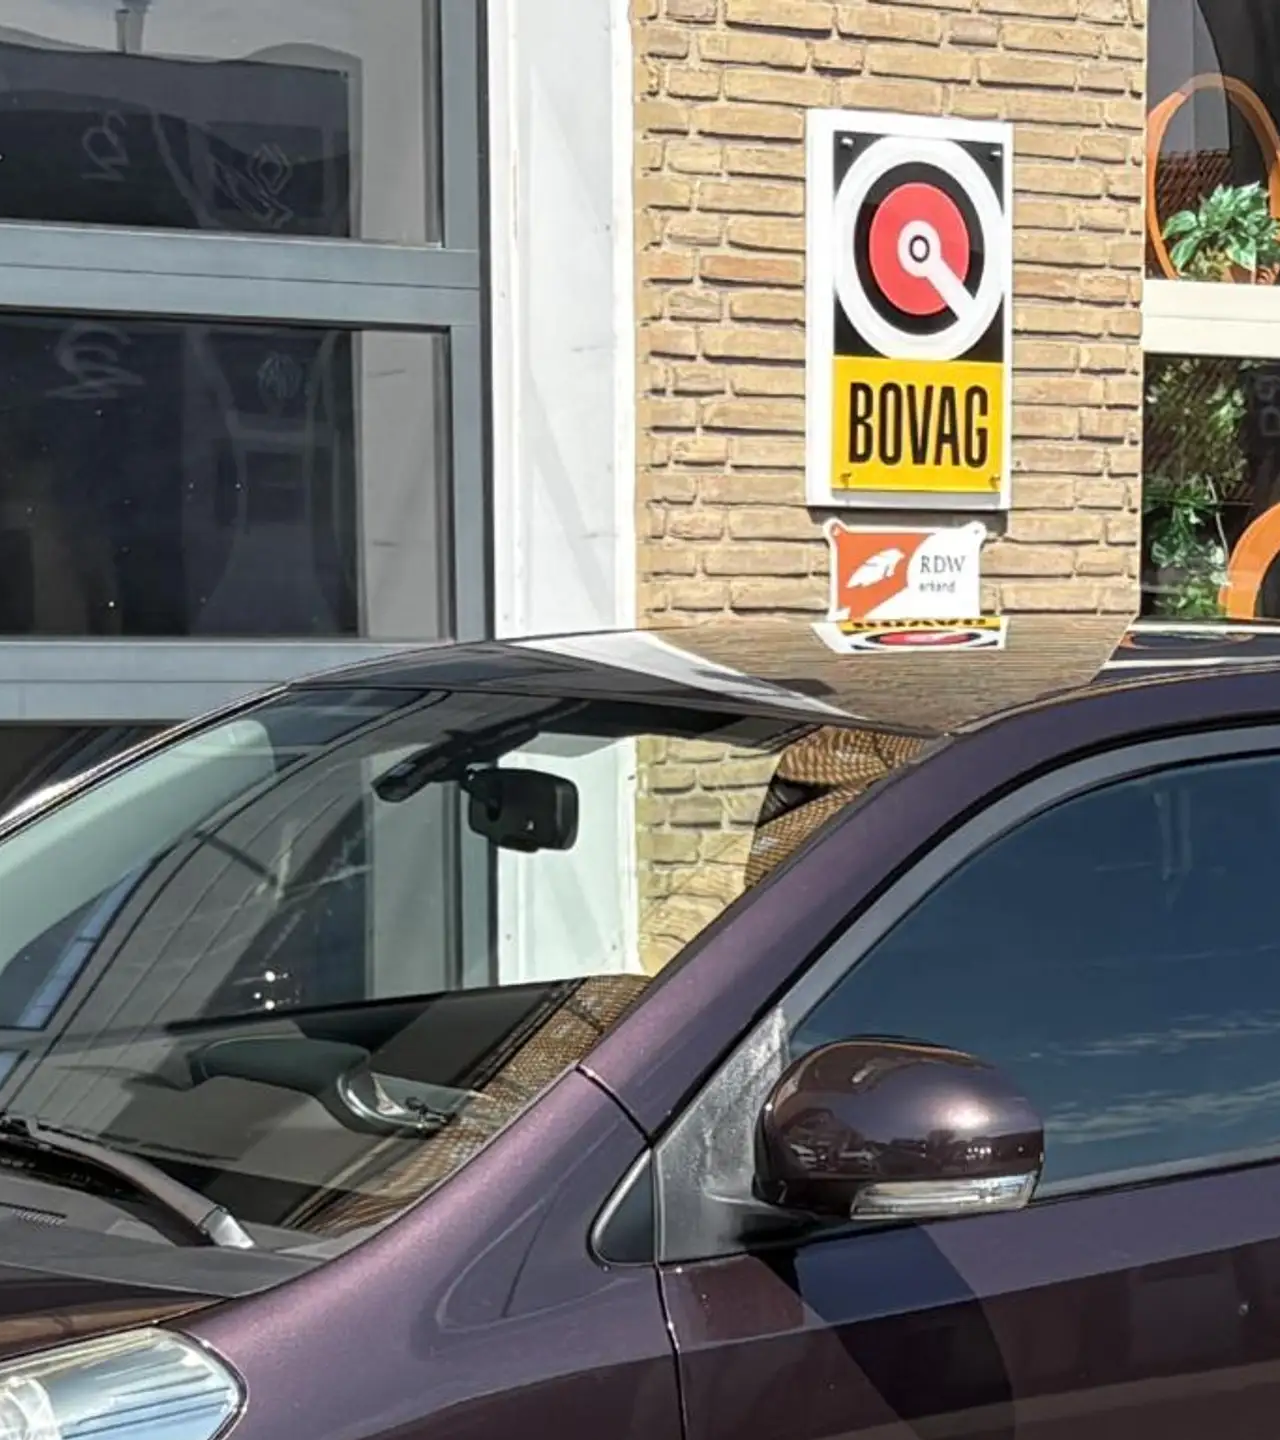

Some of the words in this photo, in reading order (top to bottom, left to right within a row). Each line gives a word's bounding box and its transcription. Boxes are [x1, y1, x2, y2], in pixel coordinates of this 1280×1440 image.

[849, 382, 989, 467] BOVAG
[919, 555, 966, 574] RDW
[919, 581, 956, 593] erkend
